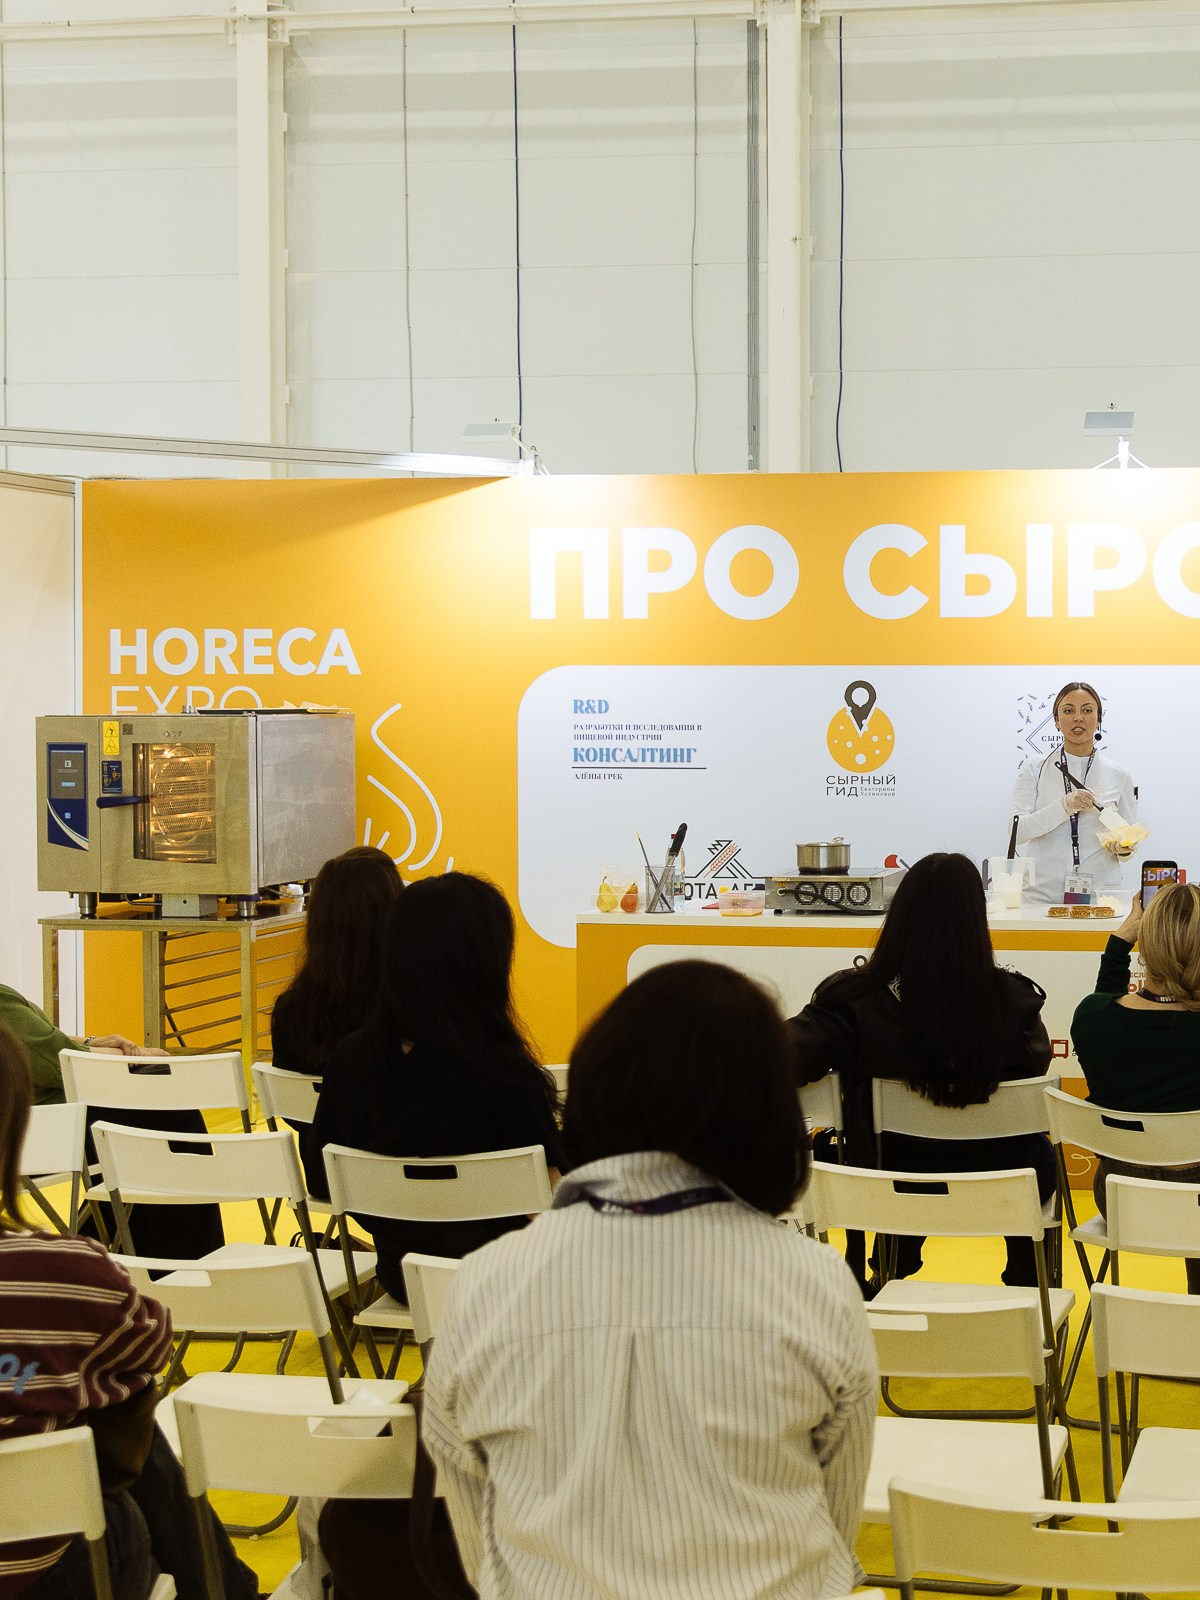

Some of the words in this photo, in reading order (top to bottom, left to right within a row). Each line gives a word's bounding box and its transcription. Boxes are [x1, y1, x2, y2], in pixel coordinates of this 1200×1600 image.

[529, 523, 800, 621] ПРО
[109, 627, 362, 676] HORECA
[573, 698, 610, 715] R&D
[573, 724, 623, 732] РАЗРАБОТКИ
[633, 724, 696, 733] ИССЛЕДОВАНИЯ
[573, 733, 613, 742] ПИЩЕВОЙ
[615, 734, 663, 742] ИНДУСТРИИ
[573, 747, 697, 763] КОНСАЛТИНГ
[574, 772, 601, 780] АЛЁНЫ
[826, 774, 896, 785] СЫРНЫЙ
[826, 786, 859, 797] ГИД
